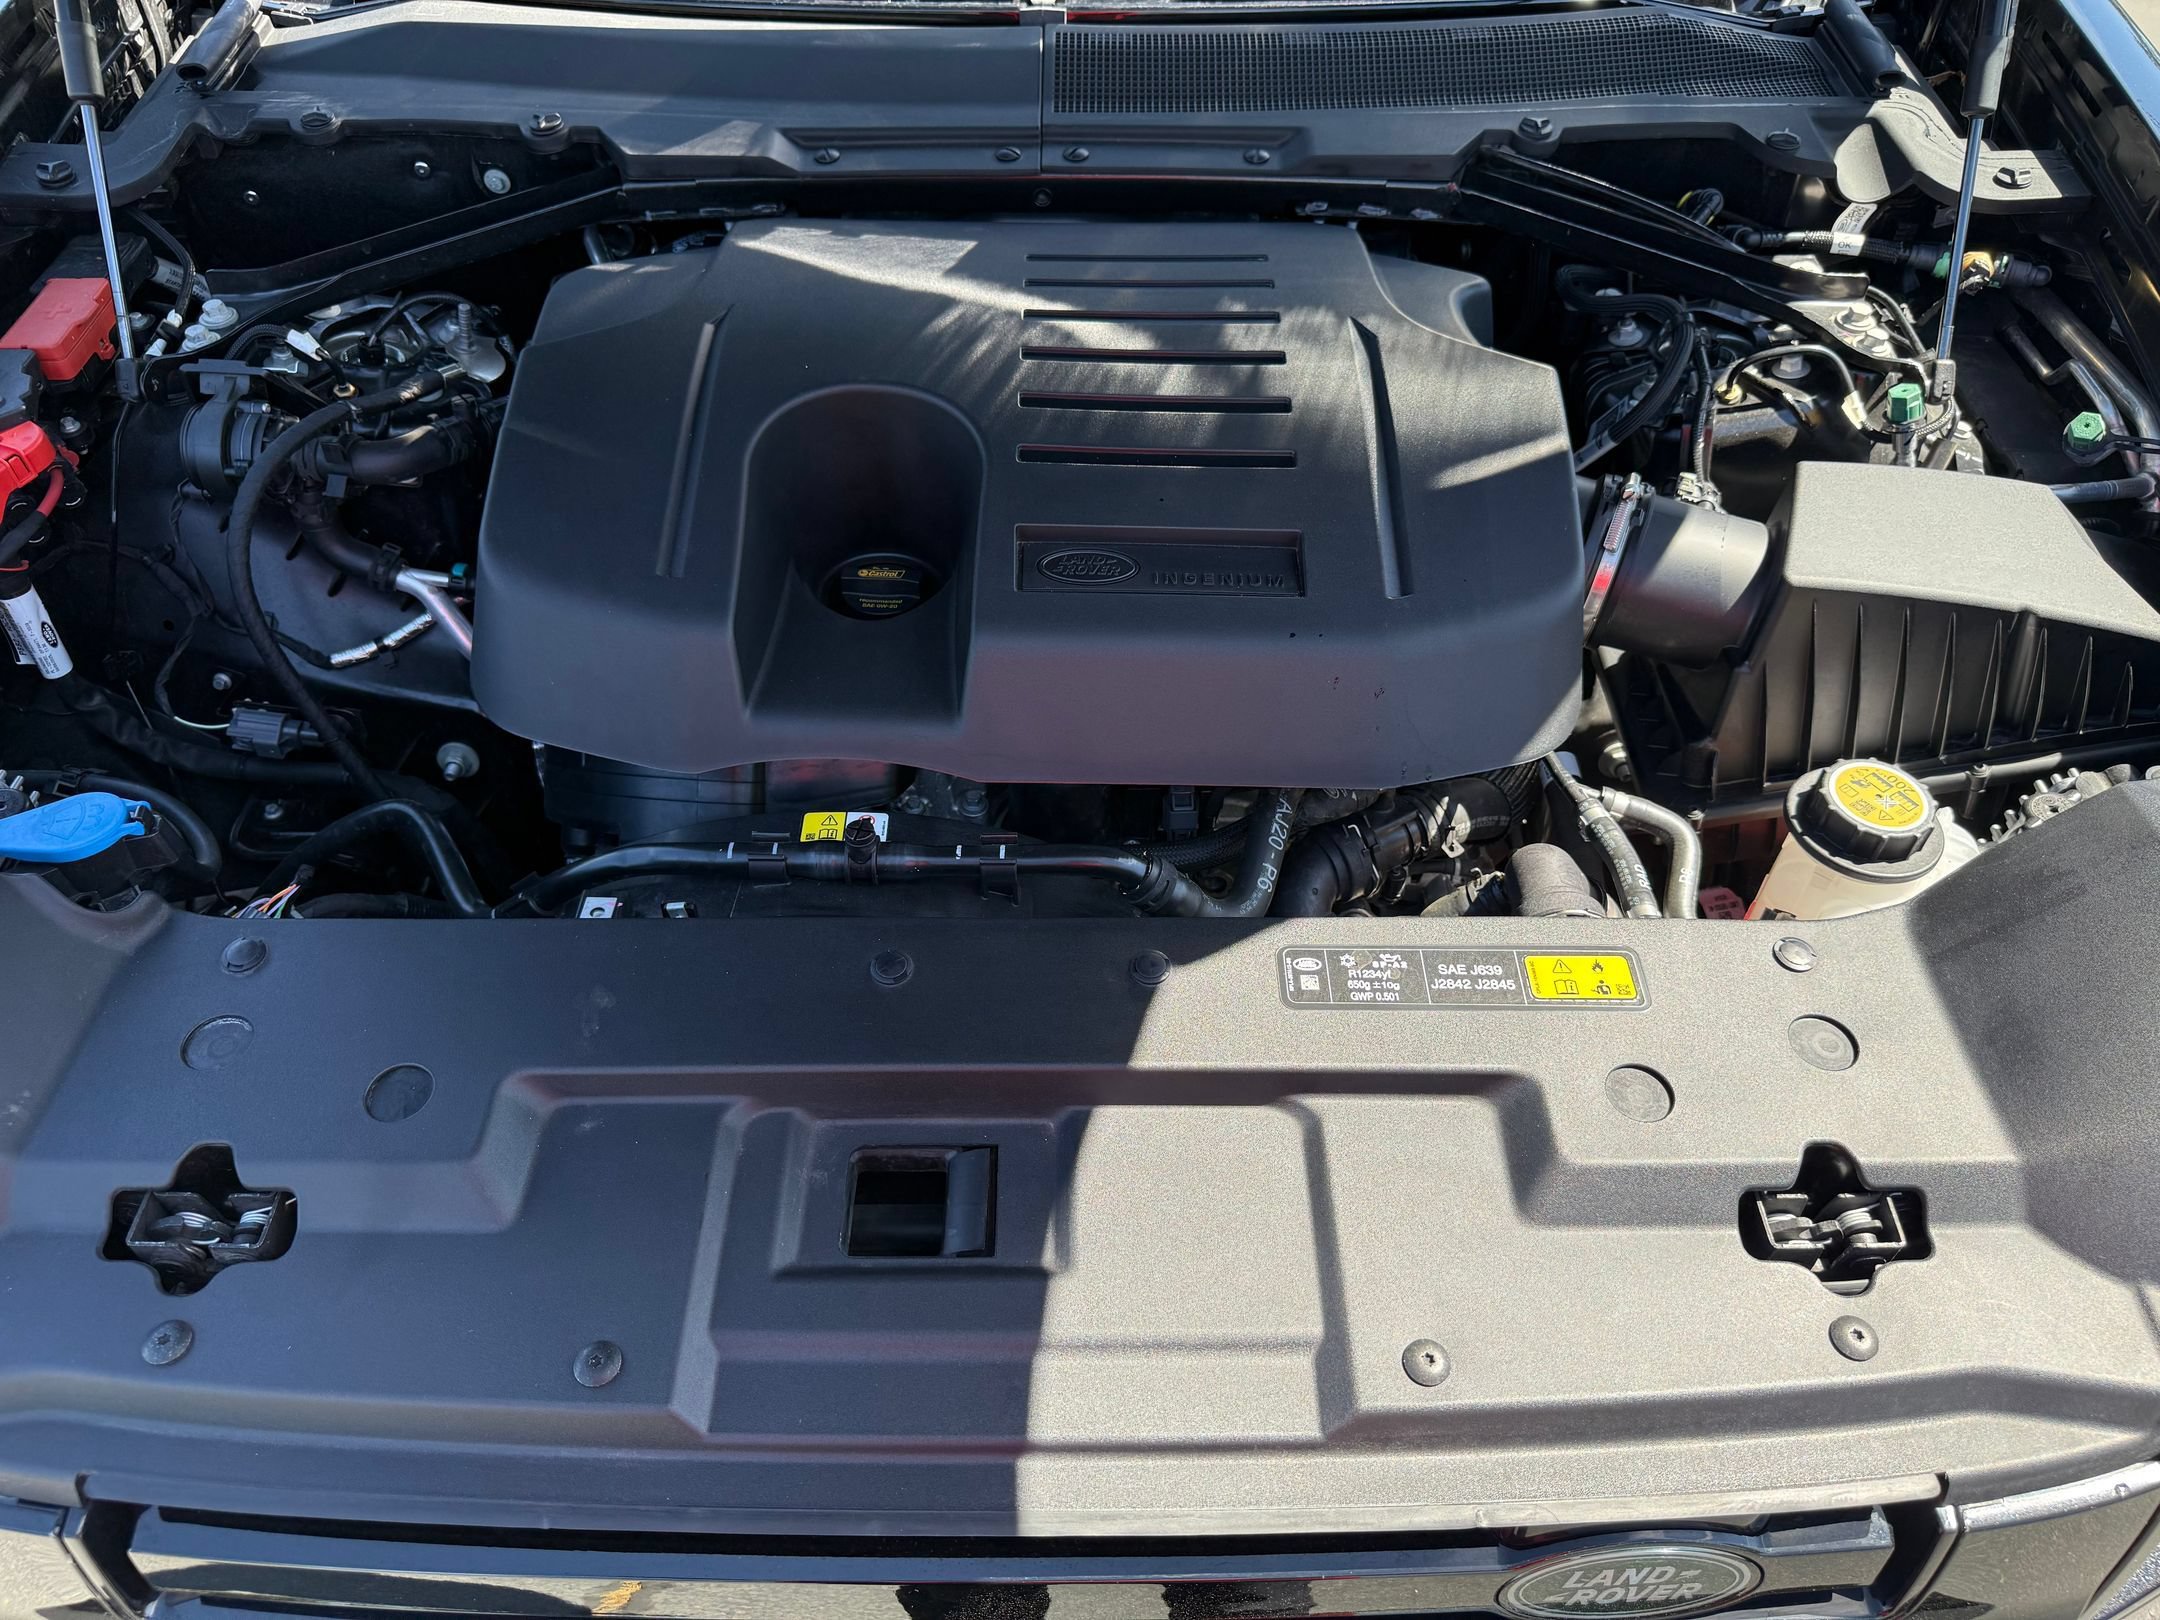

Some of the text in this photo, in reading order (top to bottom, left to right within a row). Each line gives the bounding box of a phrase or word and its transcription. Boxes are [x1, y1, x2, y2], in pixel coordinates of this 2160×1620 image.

[1060, 555, 1107, 565] LAND
[869, 570, 898, 578] Castrol
[1062, 564, 1120, 575] ROVER
[1153, 571, 1285, 588] INGENIUM
[1268, 798, 1292, 850] AJ20
[1257, 862, 1277, 893] P6
[1438, 964, 1503, 975] SAE J639
[1347, 980, 1371, 991] 650g
[1431, 978, 1516, 990] J2842 J2845
[1350, 991, 1400, 1001] GWP 0.501
[1562, 1565, 1676, 1589] LAND
[1565, 1582, 1702, 1606] ROVER
